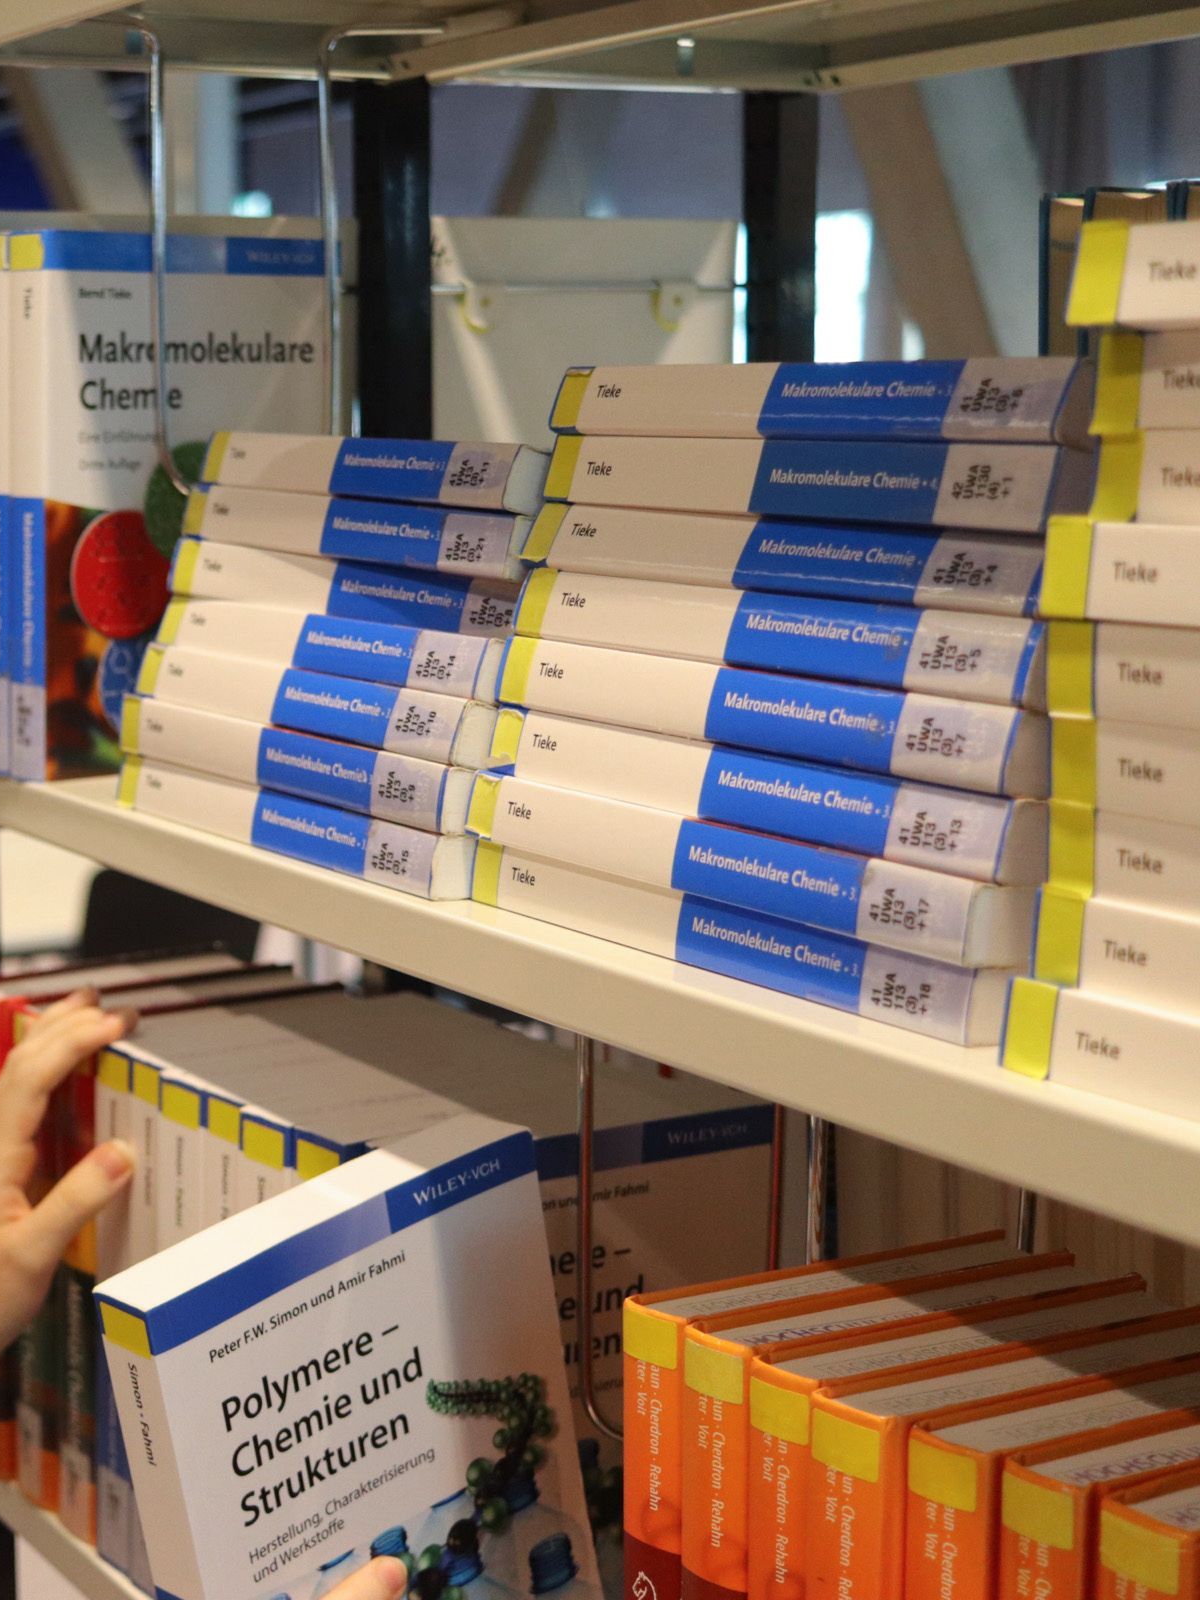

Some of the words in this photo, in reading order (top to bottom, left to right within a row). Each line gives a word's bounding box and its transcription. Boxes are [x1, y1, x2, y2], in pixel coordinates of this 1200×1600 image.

[1148, 261, 1197, 283] Tieke
[80, 378, 183, 410] Cheme
[597, 385, 621, 398] Tieke
[781, 382, 884, 398] Makromolekulare
[886, 382, 936, 398] Chemie
[449, 473, 457, 486] 41
[456, 459, 469, 487] UWA
[464, 466, 473, 485] 113
[469, 472, 479, 486] (3)
[587, 461, 612, 476] Tieke
[769, 468, 871, 487] Makromolekulare
[872, 471, 920, 489] Chemie
[952, 482, 963, 499] 42
[963, 465, 979, 499] UWA
[987, 482, 1000, 499] (4)
[571, 523, 597, 538] Tieke
[445, 547, 452, 561] 41
[452, 533, 464, 561] UWA
[460, 541, 469, 560] 113
[467, 548, 476, 562] (3)
[759, 539, 863, 562] Makromolekulare
[865, 548, 916, 568] Chemie
[933, 568, 946, 583] 41
[945, 553, 967, 584] UWA
[957, 561, 974, 584] 113
[968, 569, 984, 586] (3)
[1113, 561, 1158, 584] Tieke
[478, 598, 491, 625] UWA
[561, 592, 586, 608] Tieke
[469, 611, 478, 624] 41
[486, 605, 497, 626] 113
[494, 613, 504, 627] (3)
[746, 614, 849, 640] Makromolekulare
[851, 625, 900, 647] Chemie
[920, 653, 931, 669] 41
[931, 635, 948, 669] UWA
[943, 645, 958, 670] 113
[954, 654, 969, 672] (3)
[416, 664, 423, 677] 41
[422, 651, 435, 678] UWA
[430, 658, 440, 678] 113
[437, 665, 446, 679] (3)
[539, 662, 564, 679] Tieke
[1118, 662, 1163, 686] Tieke
[402, 706, 416, 732] UWA
[410, 714, 420, 733] 113
[724, 692, 827, 723] Makromolekulare
[828, 708, 878, 732] Chemie
[395, 719, 402, 732] 41
[416, 721, 426, 736] (3)
[917, 718, 934, 752] UWA
[532, 733, 557, 751] Tieke
[906, 734, 917, 751] 41
[929, 728, 943, 753] 113
[939, 738, 955, 756] (3)
[1118, 758, 1163, 784] Tieke
[378, 784, 385, 797] 41
[386, 771, 395, 799] UWA
[393, 780, 401, 799] 113
[400, 787, 408, 802] (3)
[718, 770, 821, 804] Makromolekulare
[823, 790, 873, 815] Chemie
[507, 801, 531, 820] Tieke
[898, 828, 910, 845] 41
[910, 811, 927, 846] UWA
[923, 822, 935, 847] 113
[933, 833, 947, 851] (3)
[372, 855, 378, 868] 41
[378, 843, 388, 870] UWA
[385, 852, 394, 871] 113
[392, 860, 401, 874] (3)
[1117, 849, 1163, 875] Tieke
[511, 867, 536, 886] Tieke
[688, 846, 789, 883] Makromolekulare
[791, 870, 839, 897] Chemie
[869, 903, 880, 921] 41
[880, 888, 896, 923] UWA
[892, 900, 904, 925] 113
[902, 911, 915, 929] (3)
[692, 917, 792, 958] Makromolekulare
[793, 945, 841, 972] Chemie
[1103, 940, 1149, 967] Tieke
[871, 988, 882, 1005] 41
[883, 973, 896, 1007] UWA
[894, 985, 906, 1009] 113
[905, 996, 918, 1014] (3)
[1075, 1032, 1121, 1060] Tieke
[412, 1158, 500, 1207] WILEY-VCH
[614, 1181, 650, 1199] Fahmi
[208, 1337, 242, 1363] Peter
[243, 1322, 268, 1349] F.W.
[269, 1302, 308, 1330] Simon
[310, 1285, 335, 1308] und
[338, 1271, 367, 1295] Amir
[368, 1250, 406, 1279] Fahmi
[221, 1331, 373, 1432] Polymere
[128, 1362, 144, 1410] Simon
[141, 1422, 157, 1467] Fahmi
[231, 1393, 352, 1477] Chemie
[360, 1346, 423, 1405] und
[637, 1392, 647, 1416] Voit
[650, 1398, 662, 1455] Cherdron
[241, 1413, 410, 1528] Strukturen
[712, 1431, 726, 1489] Cherdron
[649, 1464, 662, 1511] Rehahn
[776, 1464, 790, 1524] Cherdron
[248, 1512, 324, 1564] Herstellung,
[324, 1447, 436, 1515] Charakterisierung
[711, 1500, 724, 1547] Rehahn
[839, 1505, 855, 1566] Cherdron
[253, 1561, 278, 1583] und
[279, 1517, 345, 1566] Werkstoffe
[775, 1534, 788, 1584] Rehahn
